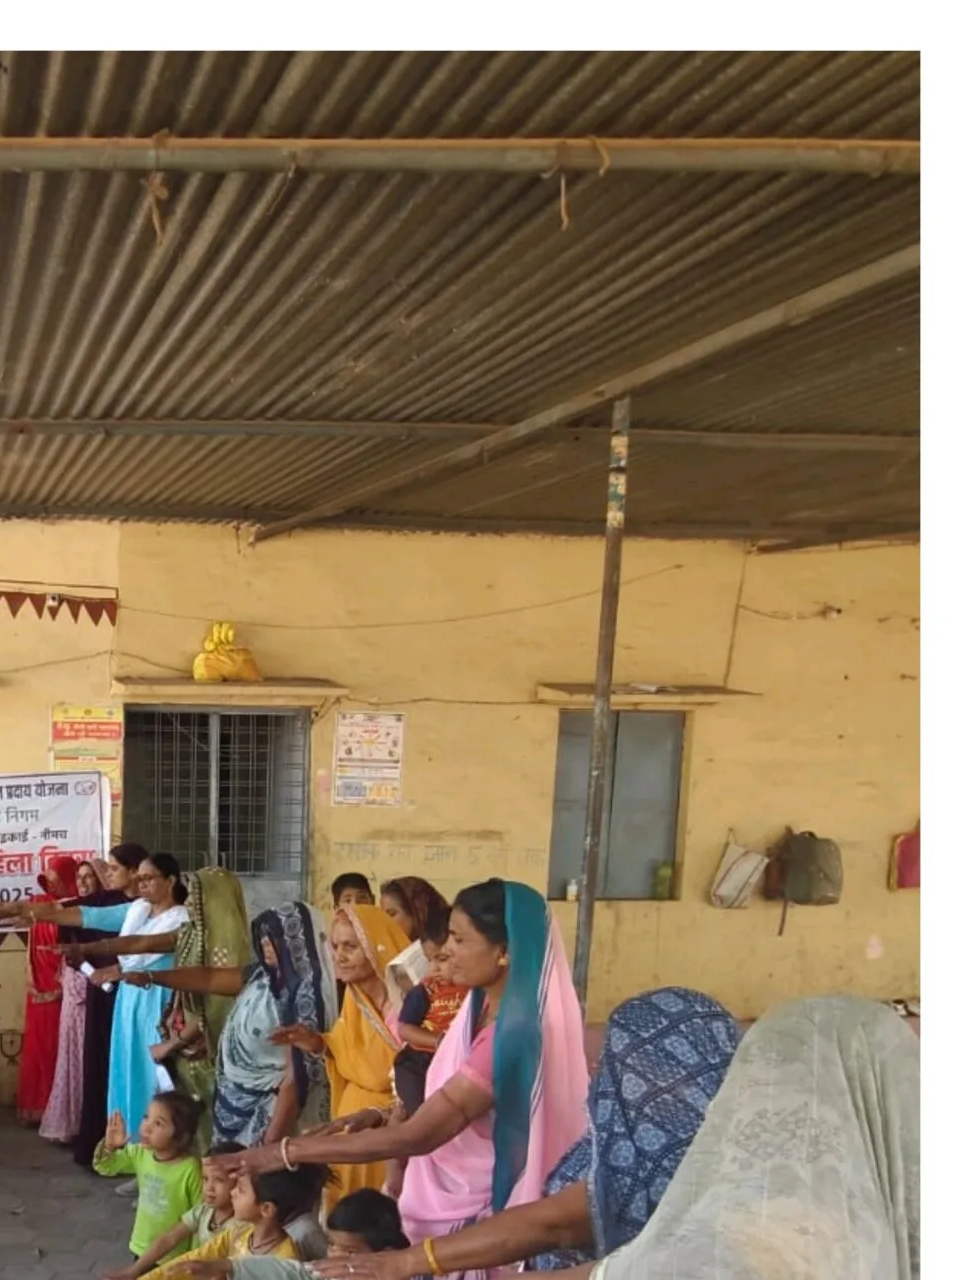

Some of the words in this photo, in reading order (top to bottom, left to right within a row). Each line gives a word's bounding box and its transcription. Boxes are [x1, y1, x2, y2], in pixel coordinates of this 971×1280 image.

[6, 784, 31, 800] प्रदाय
[32, 780, 69, 797] योजना
[6, 806, 39, 823] निगम
[0, 828, 29, 844] इकाई
[40, 828, 68, 841] नीमच
